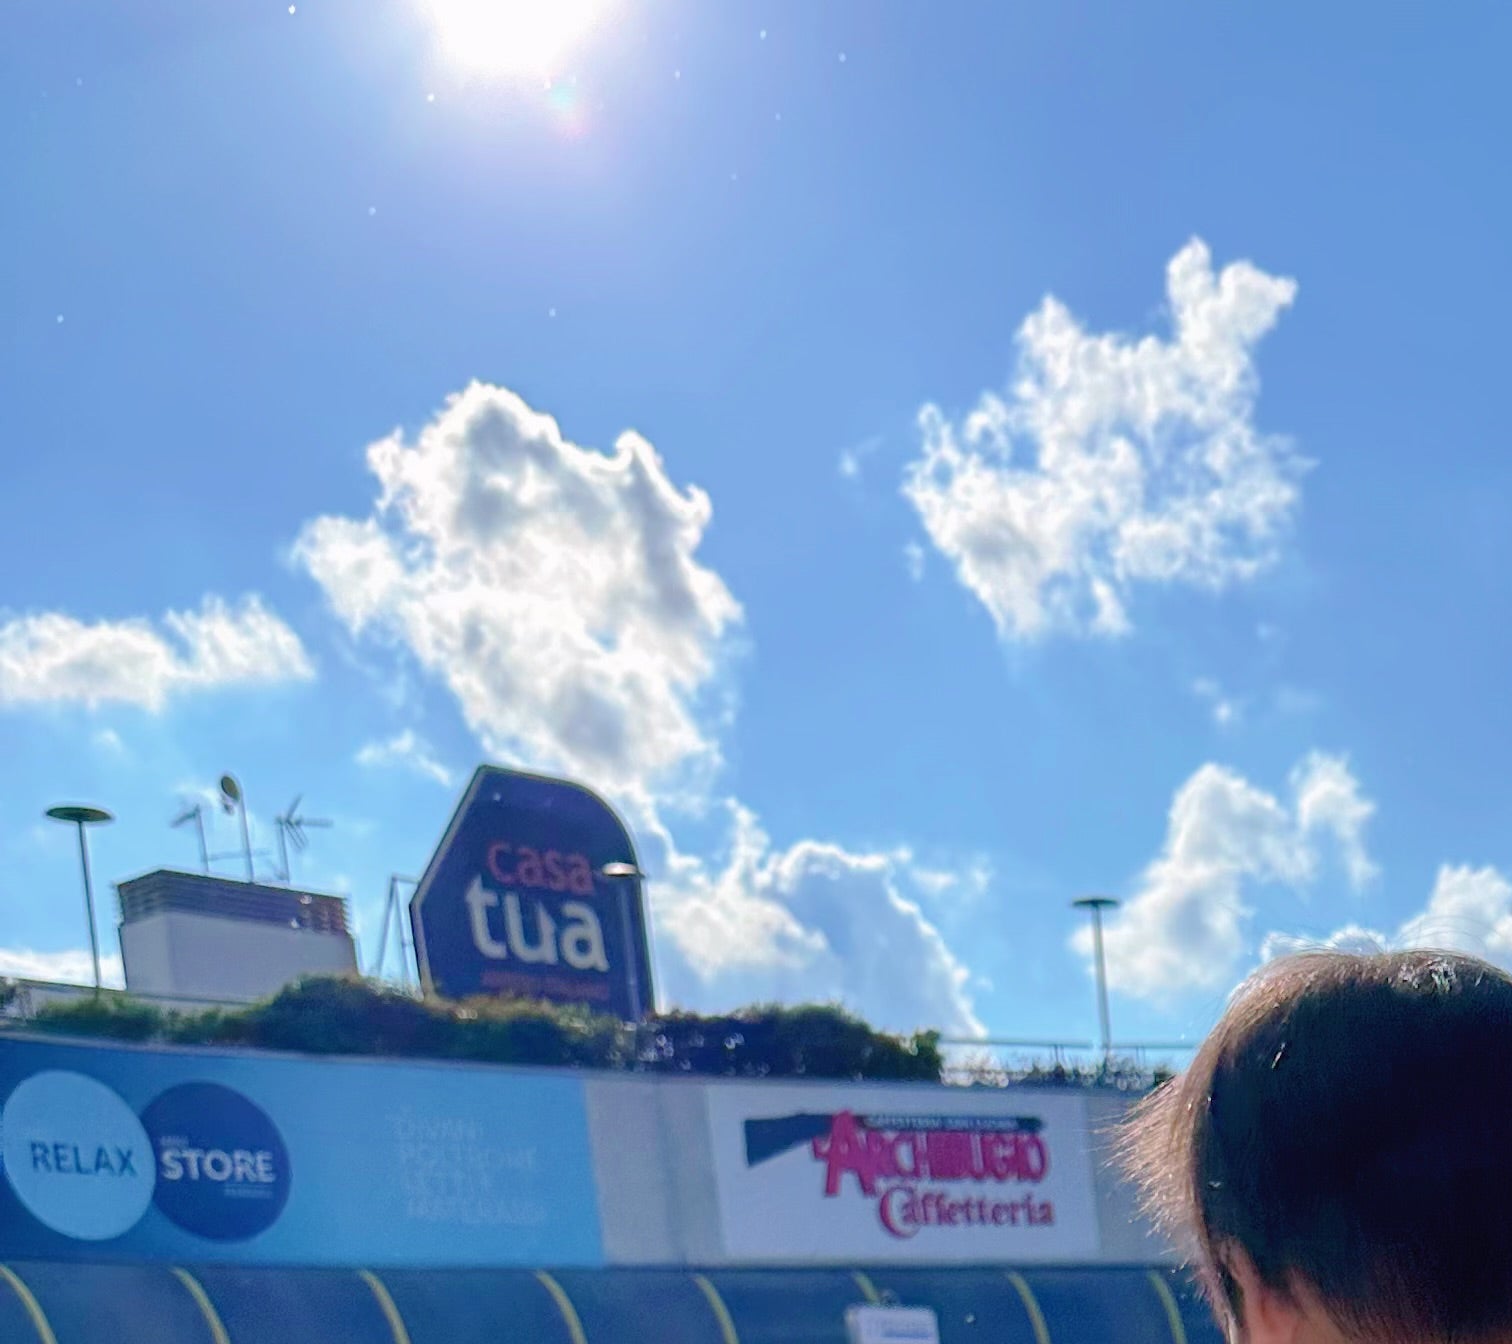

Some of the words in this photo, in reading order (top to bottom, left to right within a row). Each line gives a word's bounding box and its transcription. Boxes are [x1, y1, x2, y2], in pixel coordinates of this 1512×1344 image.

[486, 841, 597, 897] casa
[465, 873, 611, 974] tua
[31, 1140, 138, 1178] RELAX
[160, 1149, 276, 1183] STORE
[879, 1186, 1057, 1240] Caffetteria
